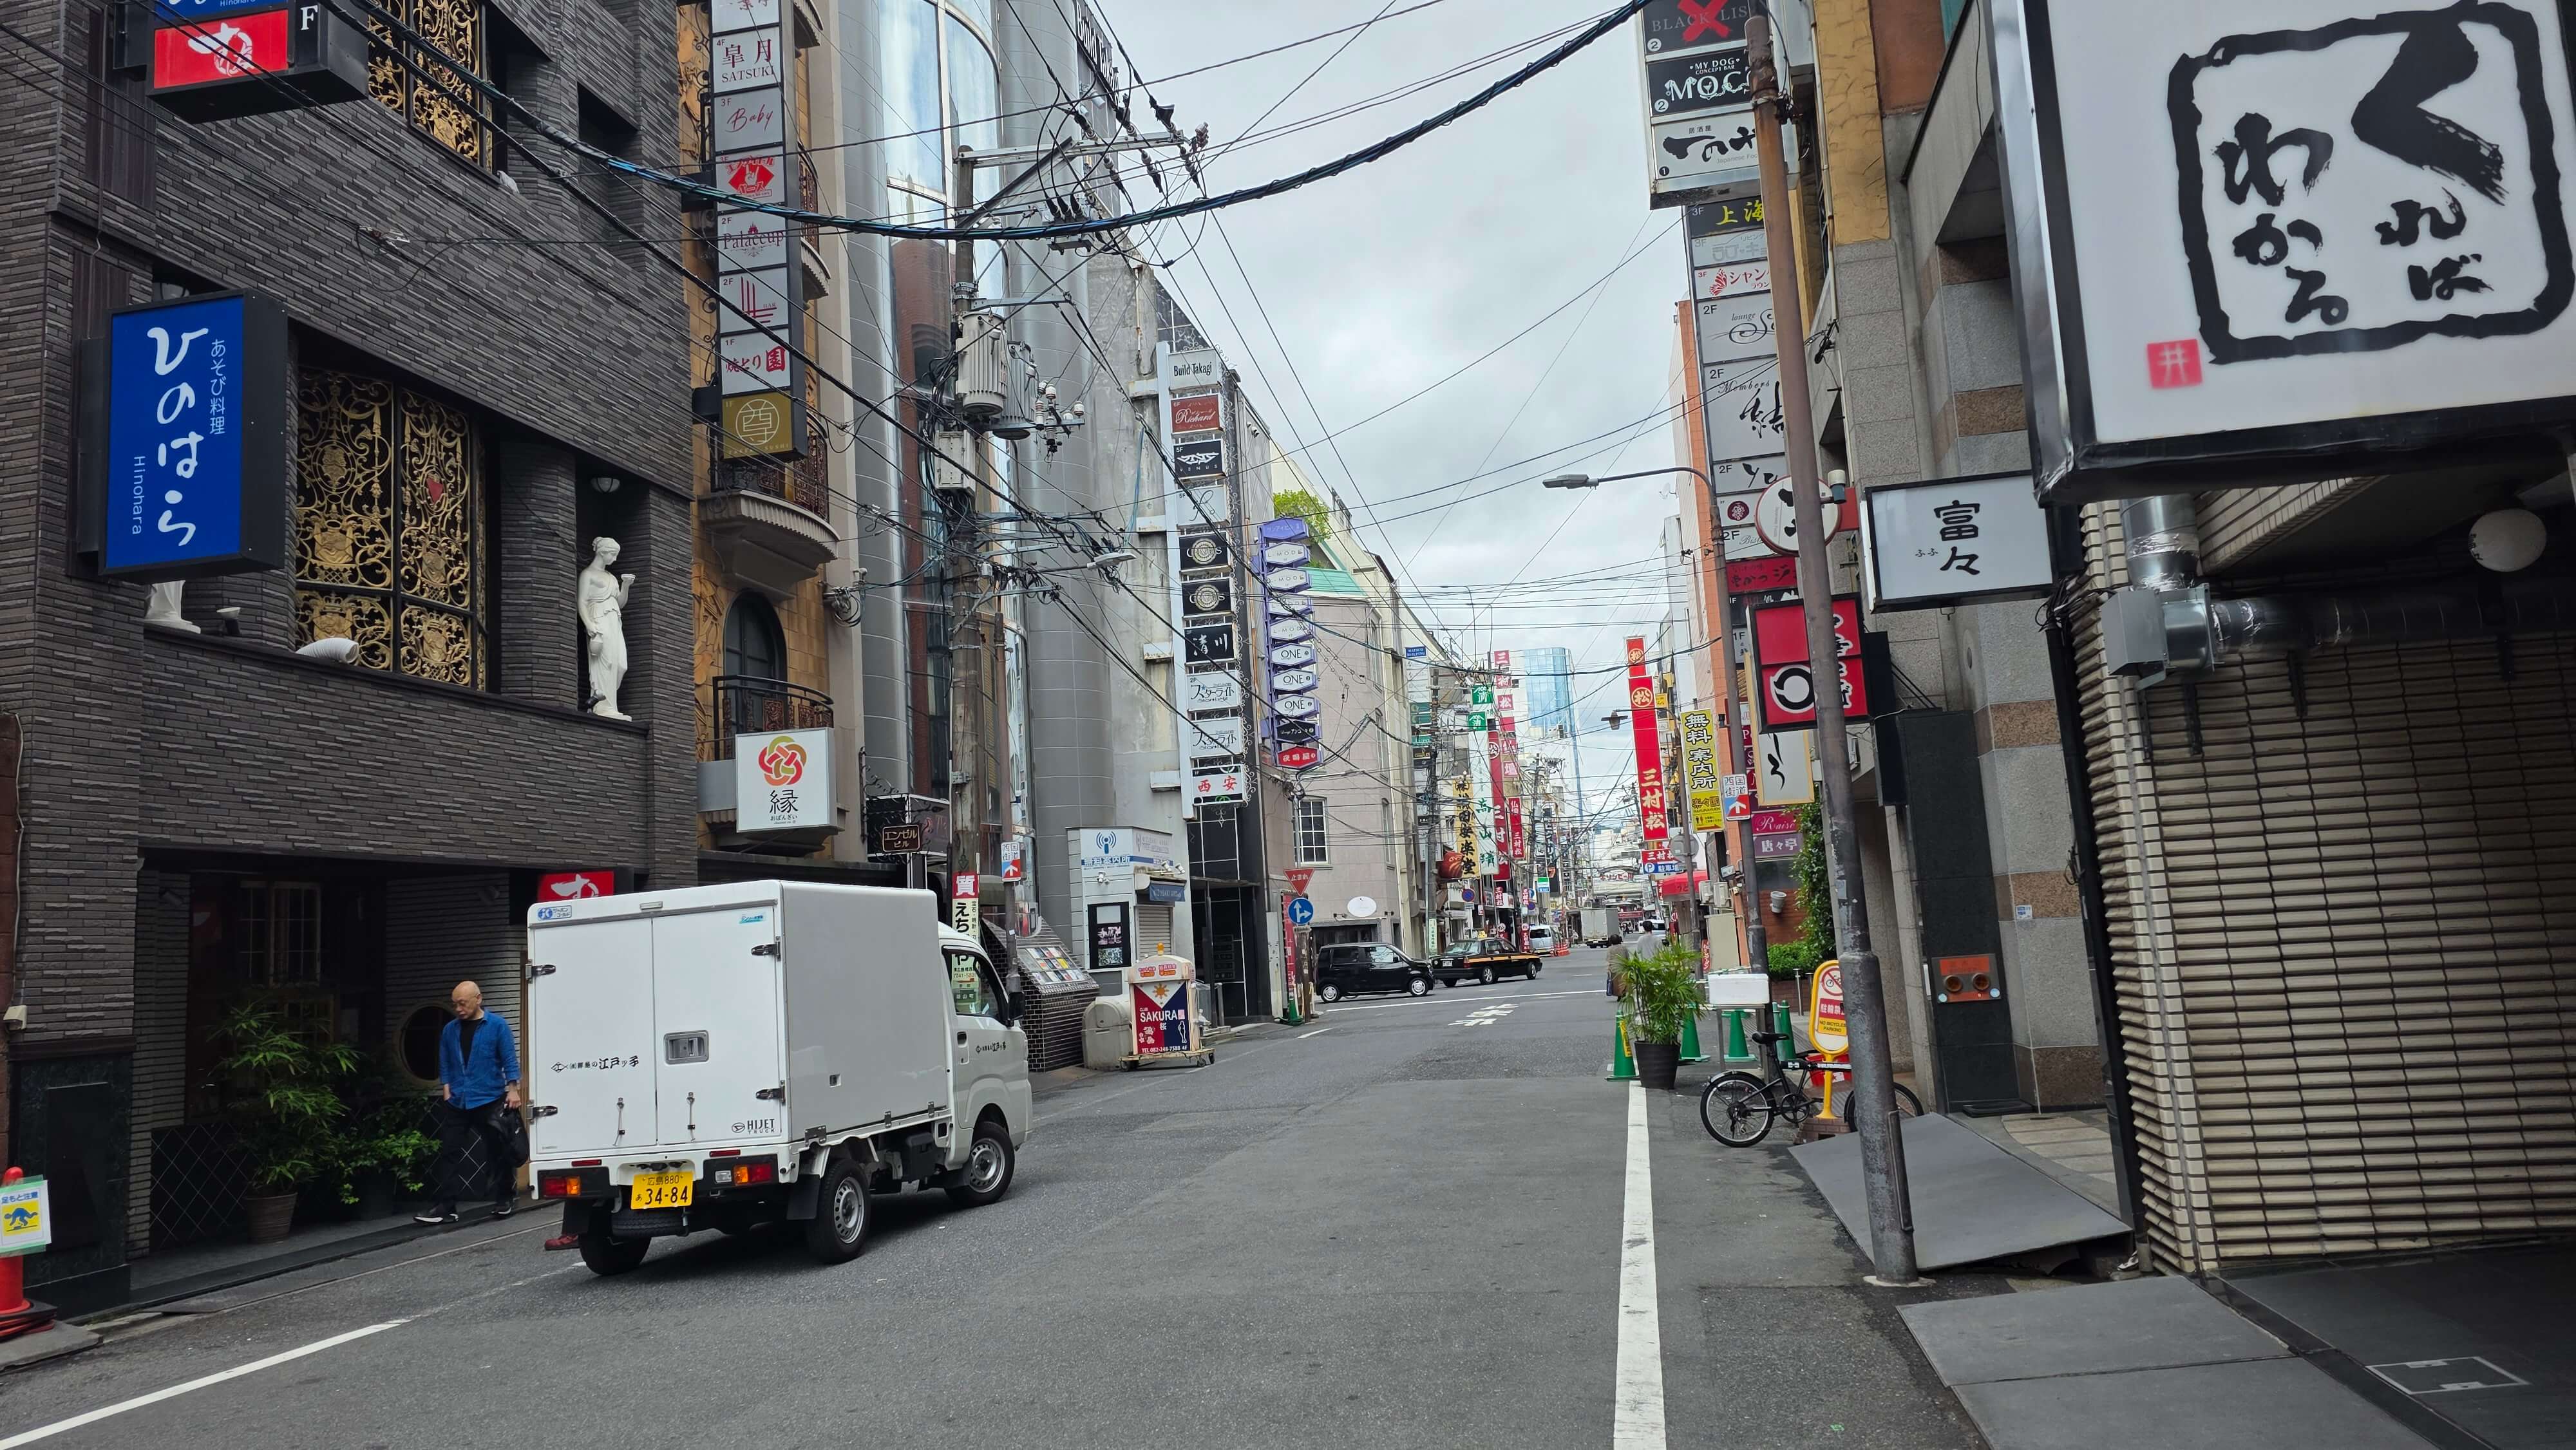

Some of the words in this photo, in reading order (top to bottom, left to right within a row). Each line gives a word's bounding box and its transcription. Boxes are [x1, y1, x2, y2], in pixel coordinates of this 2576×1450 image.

[1652, 12, 1711, 32] BLACK
[1721, 5, 1749, 21] LIS
[716, 39, 726, 47] 4F
[1695, 62, 1710, 70] MY
[1712, 57, 1735, 67] DOG
[721, 66, 775, 83] SATSUKI
[1696, 66, 1722, 75] CONCEPT
[721, 97, 732, 107] 3F
[725, 104, 773, 133] Baby
[1689, 125, 1712, 135] 居酒屋
[1692, 207, 1705, 216] 3F
[721, 216, 732, 225] 2F
[2211, 112, 2349, 325] わかる
[1694, 238, 1707, 248] 3F
[1730, 268, 1770, 285] シャン
[1703, 305, 1718, 315] 2F
[1732, 312, 1756, 321] lounge
[1173, 365, 1190, 377] Build
[1191, 361, 1213, 376] Takagi
[1709, 368, 1725, 379] 2F
[209, 339, 225, 437] あそび料理
[147, 326, 209, 547] ひのはら
[1719, 464, 1732, 474] 2F
[133, 455, 146, 536] Hinohara
[1721, 531, 1740, 541] 2F
[1933, 500, 1980, 575] 富々
[1733, 632, 1745, 640] 1F
[1281, 648, 1302, 659] ONE
[1283, 674, 1303, 684] ONE
[1634, 690, 1650, 705] 松
[1285, 699, 1305, 710] ONE
[1685, 713, 1717, 789] 無料案内所
[1198, 775, 1238, 793] 西安
[1725, 775, 1745, 786] 西国
[1725, 786, 1747, 798] 街道
[770, 789, 799, 814] 縁
[1641, 768, 1665, 831] 三村松
[884, 829, 918, 841] エンゼル
[1513, 831, 1522, 856] 三村松
[1084, 856, 1130, 867] 無料案内所
[1291, 873, 1309, 881] 止まれ
[1600, 872, 1634, 881] キリンビール
[956, 875, 975, 896] 質
[1140, 1009, 1178, 1022] SAKURA
[747, 1118, 775, 1131] HIJET
[1, 1191, 39, 1205] 足もと注意
[645, 1185, 688, 1205] 34-84
